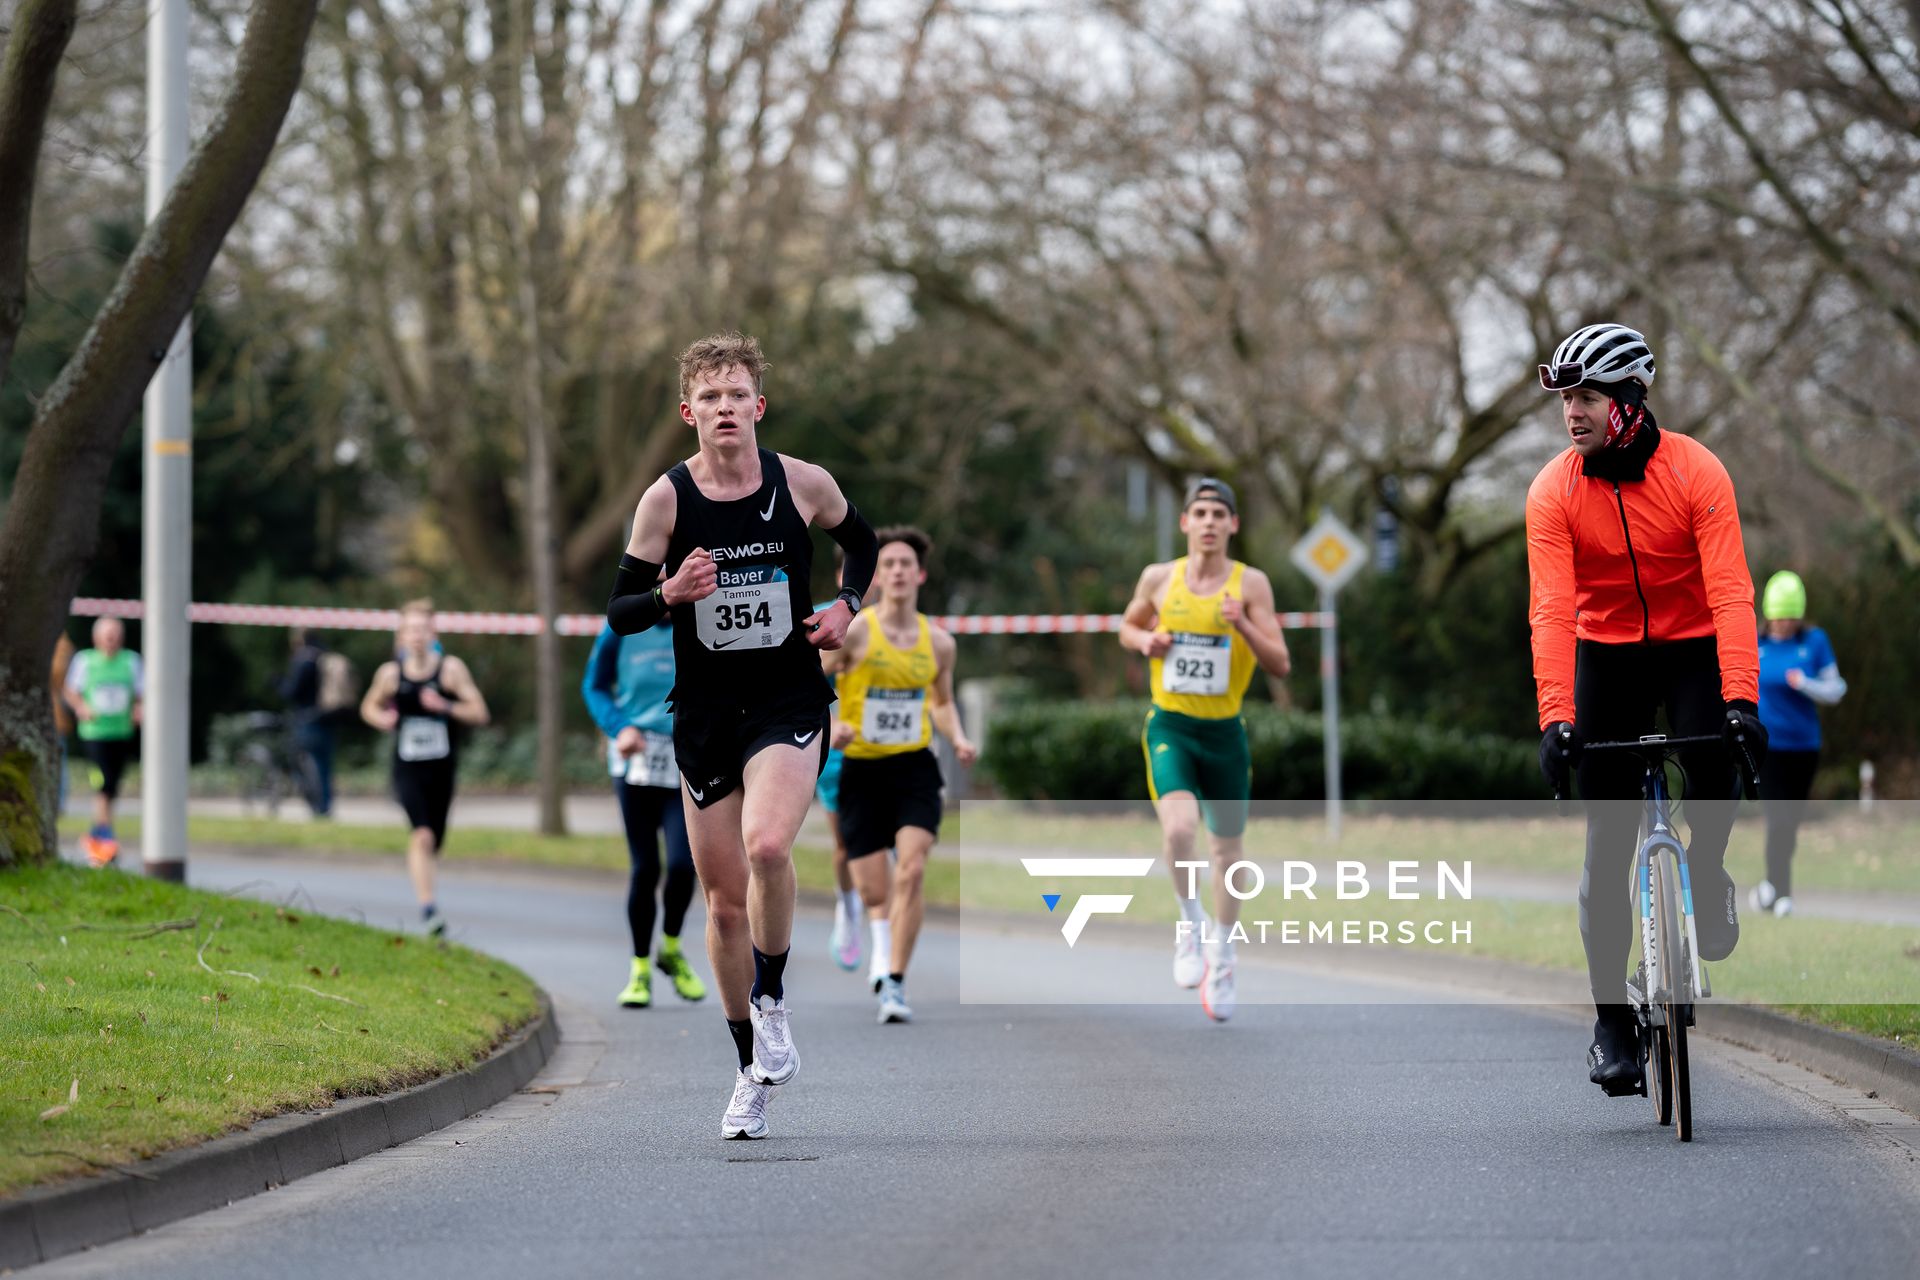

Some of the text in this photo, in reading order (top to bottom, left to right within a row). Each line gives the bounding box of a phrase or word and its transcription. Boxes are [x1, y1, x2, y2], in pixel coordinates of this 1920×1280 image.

[720, 570, 764, 585] Bayer
[722, 589, 761, 600] Tammo
[715, 601, 772, 631] 354
[1176, 658, 1214, 679] 923
[877, 711, 912, 730] 924
